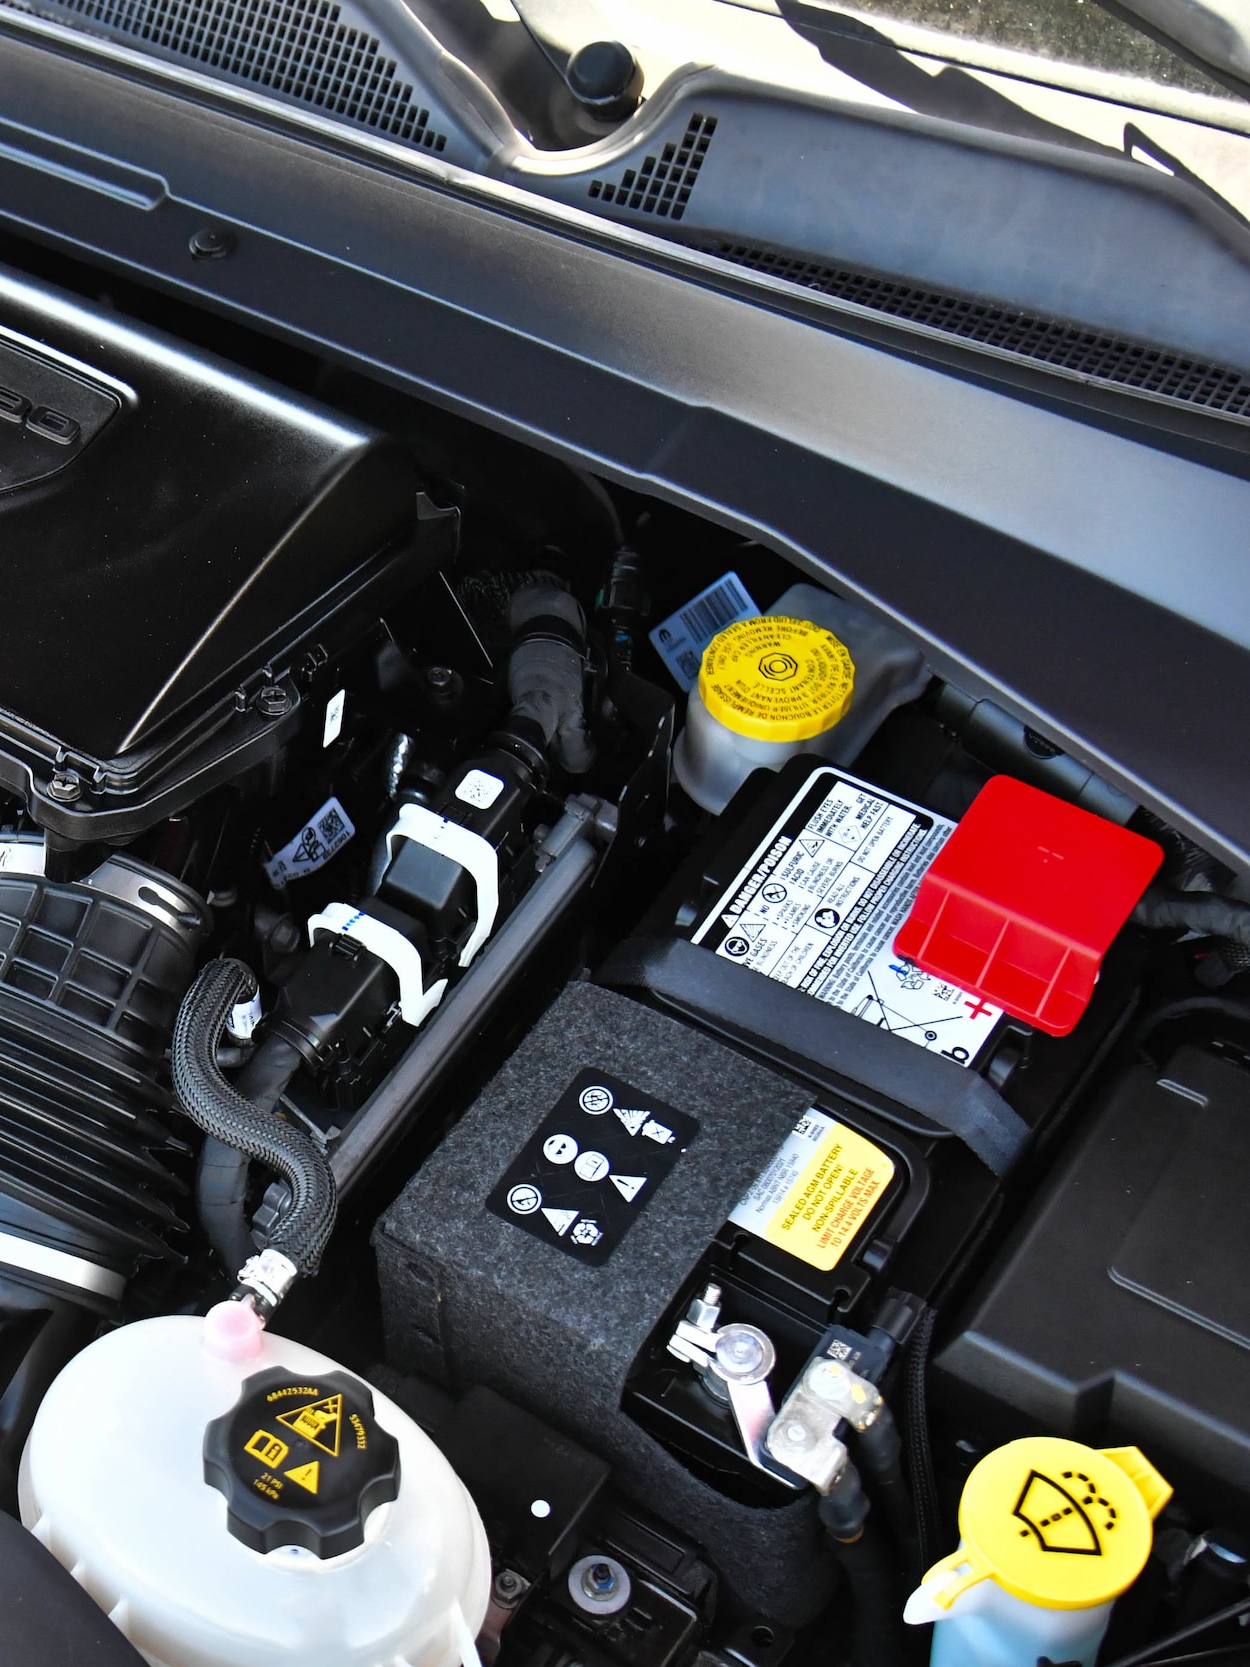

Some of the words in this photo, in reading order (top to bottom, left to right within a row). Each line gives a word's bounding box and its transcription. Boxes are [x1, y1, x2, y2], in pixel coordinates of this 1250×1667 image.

[749, 617, 770, 626] FROM
[777, 625, 807, 636] BEFORE
[733, 626, 772, 641] REMOVING
[739, 636, 761, 650] FILLER
[744, 641, 780, 657] WARNING
[750, 692, 801, 703] PROVENANT
[770, 711, 811, 720] BOUCHON
[855, 793, 867, 804] GET
[855, 797, 875, 820] MEDICAL
[807, 812, 823, 829] FLUSH
[819, 798, 833, 812] EYES
[816, 799, 844, 833] IMMEDIATELY
[860, 815, 873, 829] HELP
[824, 822, 838, 837] WITH
[861, 846, 872, 856] NOT
[867, 834, 880, 847] OPEN
[728, 834, 792, 915] DANGER/POISON
[780, 850, 804, 878] SULFURIC
[790, 867, 804, 882] ACID
[799, 875, 810, 886] CAN
[806, 860, 821, 876] CAUSE
[807, 864, 829, 890] BLINDNESS
[825, 857, 834, 865] OR
[815, 876, 832, 894] SEVERE
[827, 859, 843, 877] BURNS
[826, 891, 839, 904] READ
[835, 882, 845, 892] ALL
[759, 904, 770, 914] NO
[831, 988, 840, 996] the
[836, 976, 848, 989] State
[847, 952, 865, 973] California
[864, 935, 877, 948] cause
[873, 921, 886, 936] cancer
[882, 913, 892, 922] and
[887, 889, 909, 914] reproductive
[912, 859, 929, 878] Batteries
[925, 851, 935, 860] also
[931, 836, 945, 852] contain
[941, 826, 952, 837] other
[832, 962, 847, 979] Battery
[851, 931, 868, 951] terminals
[865, 923, 874, 932] and
[870, 909, 884, 924] related
[880, 886, 900, 909] accessories
[896, 871, 910, 887] contain
[906, 862, 916, 872] lead
[912, 854, 922, 863] and
[918, 846, 928, 855] lead
[749, 937, 767, 957] GASES
[839, 991, 848, 1000] the
[844, 980, 856, 992] State
[855, 955, 873, 976] California
[872, 939, 885, 952] cause
[890, 911, 904, 925] WASH
[899, 897, 913, 913] HANDS
[753, 1188, 764, 1201] SAC
[755, 1193, 771, 1213] Normas
[768, 1179, 781, 1194] ABNT
[777, 1167, 789, 1181] NBR
[781, 1197, 807, 1231] SEALED
[802, 1178, 819, 1198] AGM
[815, 1143, 843, 1179] BATTERY
[802, 1206, 815, 1220] DO
[810, 1189, 826, 1207] NOT
[822, 1163, 844, 1190] OPEN!
[811, 1167, 858, 1232] NON-SPILLABLE
[816, 1226, 835, 1249] LIMIT
[829, 1198, 853, 1228] CHARGE
[848, 1166, 874, 1200] VOLTAGE
[830, 1236, 842, 1248] TO
[837, 1219, 852, 1237] 14.4
[847, 1196, 868, 1221] VOLTS
[266, 1386, 318, 1402] 68442532AA
[348, 1413, 366, 1450] 53479332
[251, 1477, 268, 1492] 145
[260, 1471, 272, 1482] 21
[269, 1477, 284, 1490] PSI
